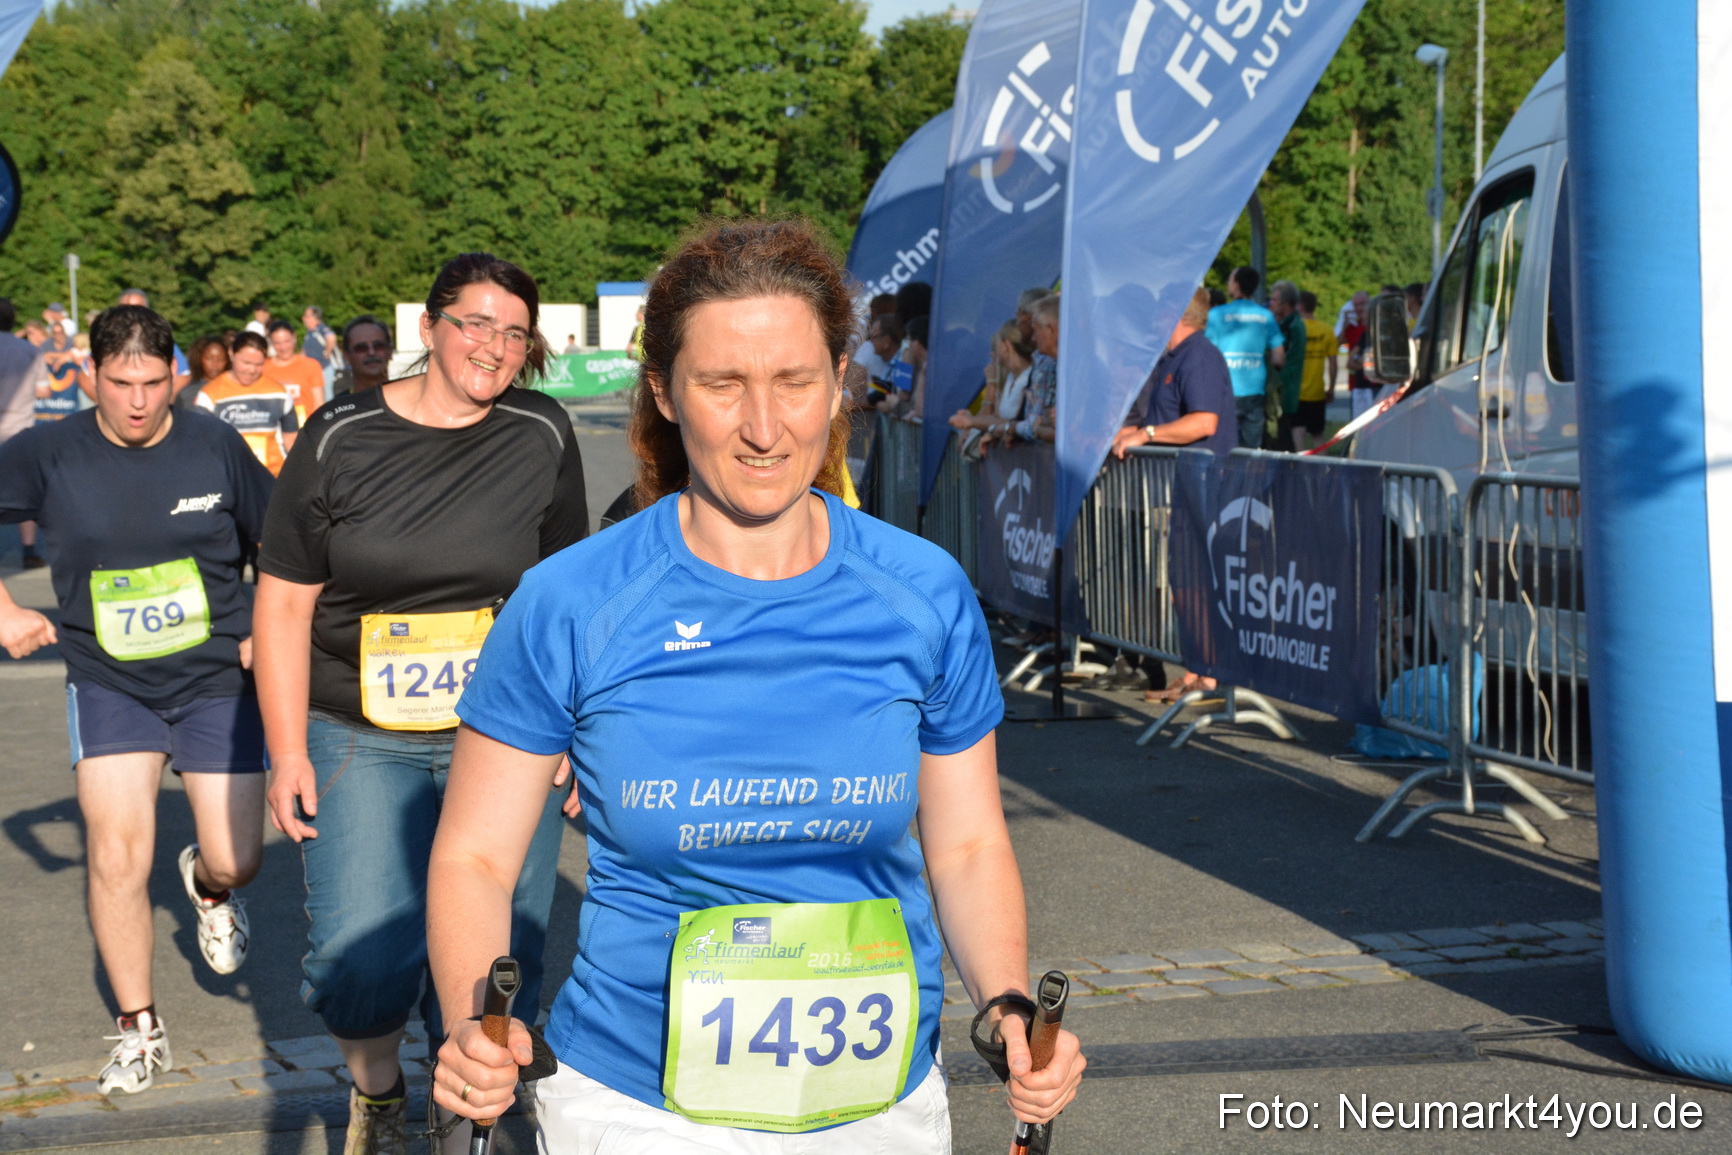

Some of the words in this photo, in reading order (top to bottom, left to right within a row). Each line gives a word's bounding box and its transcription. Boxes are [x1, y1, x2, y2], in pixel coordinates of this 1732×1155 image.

[333, 403, 356, 415] JAKO
[1225, 554, 1337, 632] Fischer
[116, 601, 185, 635] 769
[368, 648, 406, 658] walken
[664, 639, 711, 652] erima
[1239, 628, 1331, 672] AUTOMOBILE
[621, 779, 677, 810] WER
[689, 777, 818, 808] LAUFEND
[831, 772, 910, 806] DENKT,
[678, 820, 792, 852] BEWEGT
[800, 819, 872, 846] SICH
[739, 924, 767, 932] Fischer
[715, 941, 805, 960] firmenlauf
[807, 952, 853, 969] 2016
[688, 969, 724, 985] run
[702, 992, 894, 1068] 1433
